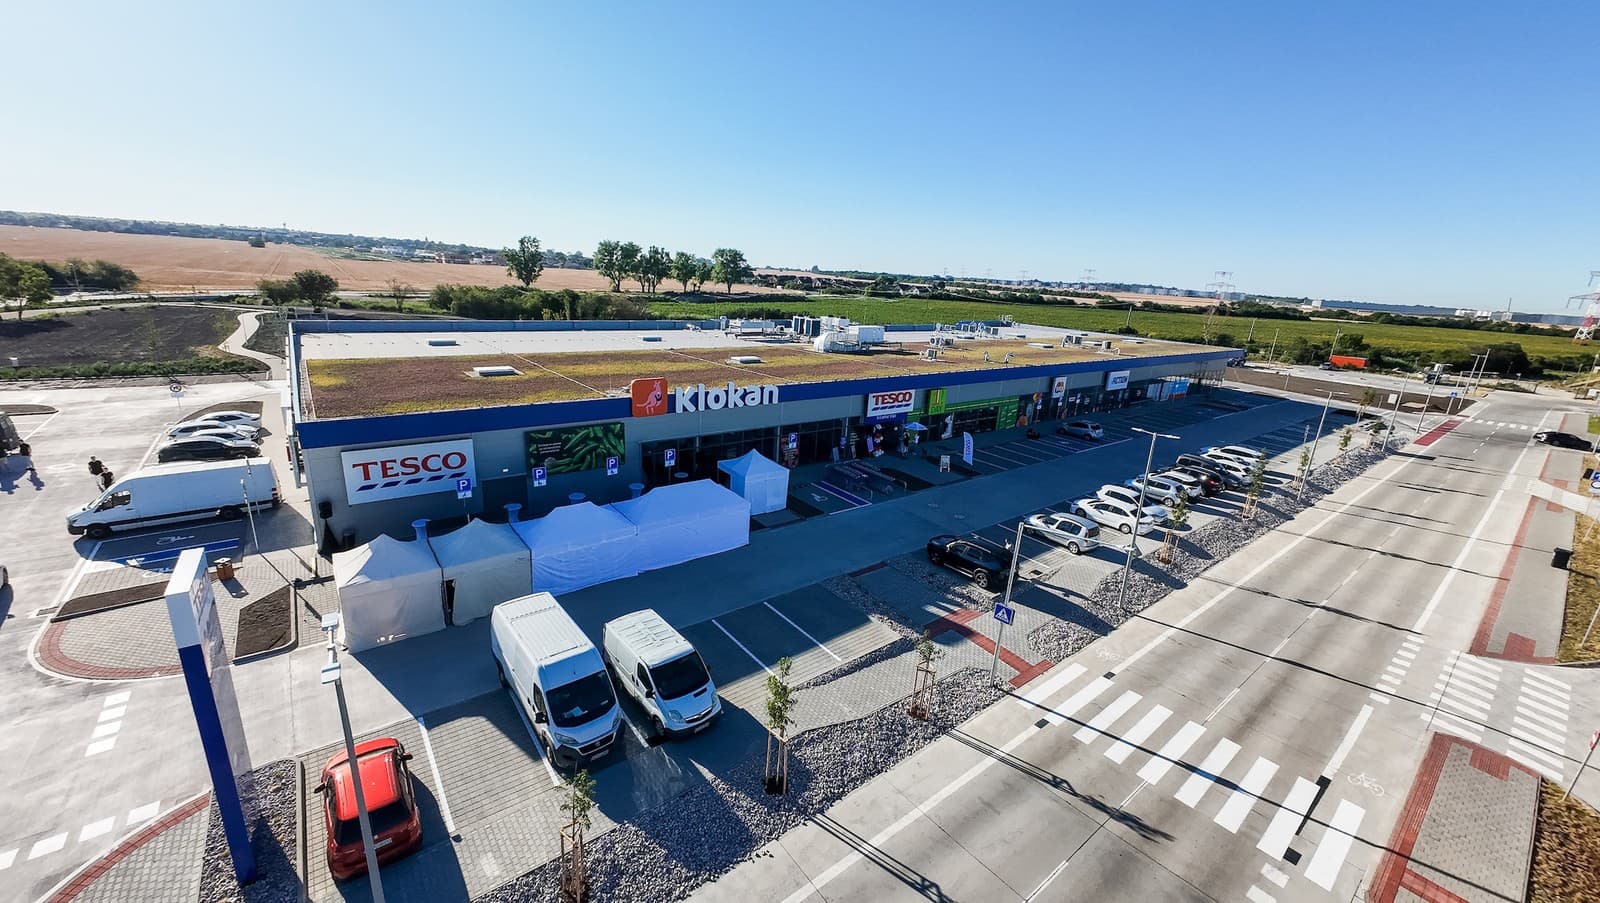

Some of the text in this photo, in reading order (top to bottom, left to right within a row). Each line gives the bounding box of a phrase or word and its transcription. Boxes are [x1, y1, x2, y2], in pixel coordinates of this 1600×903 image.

[675, 381, 779, 413] Klokan
[873, 391, 912, 406] TESCO
[667, 450, 673, 459] P
[352, 451, 467, 481] TESCO
[609, 458, 615, 468] P
[536, 469, 543, 479] P
[460, 480, 468, 490] P
